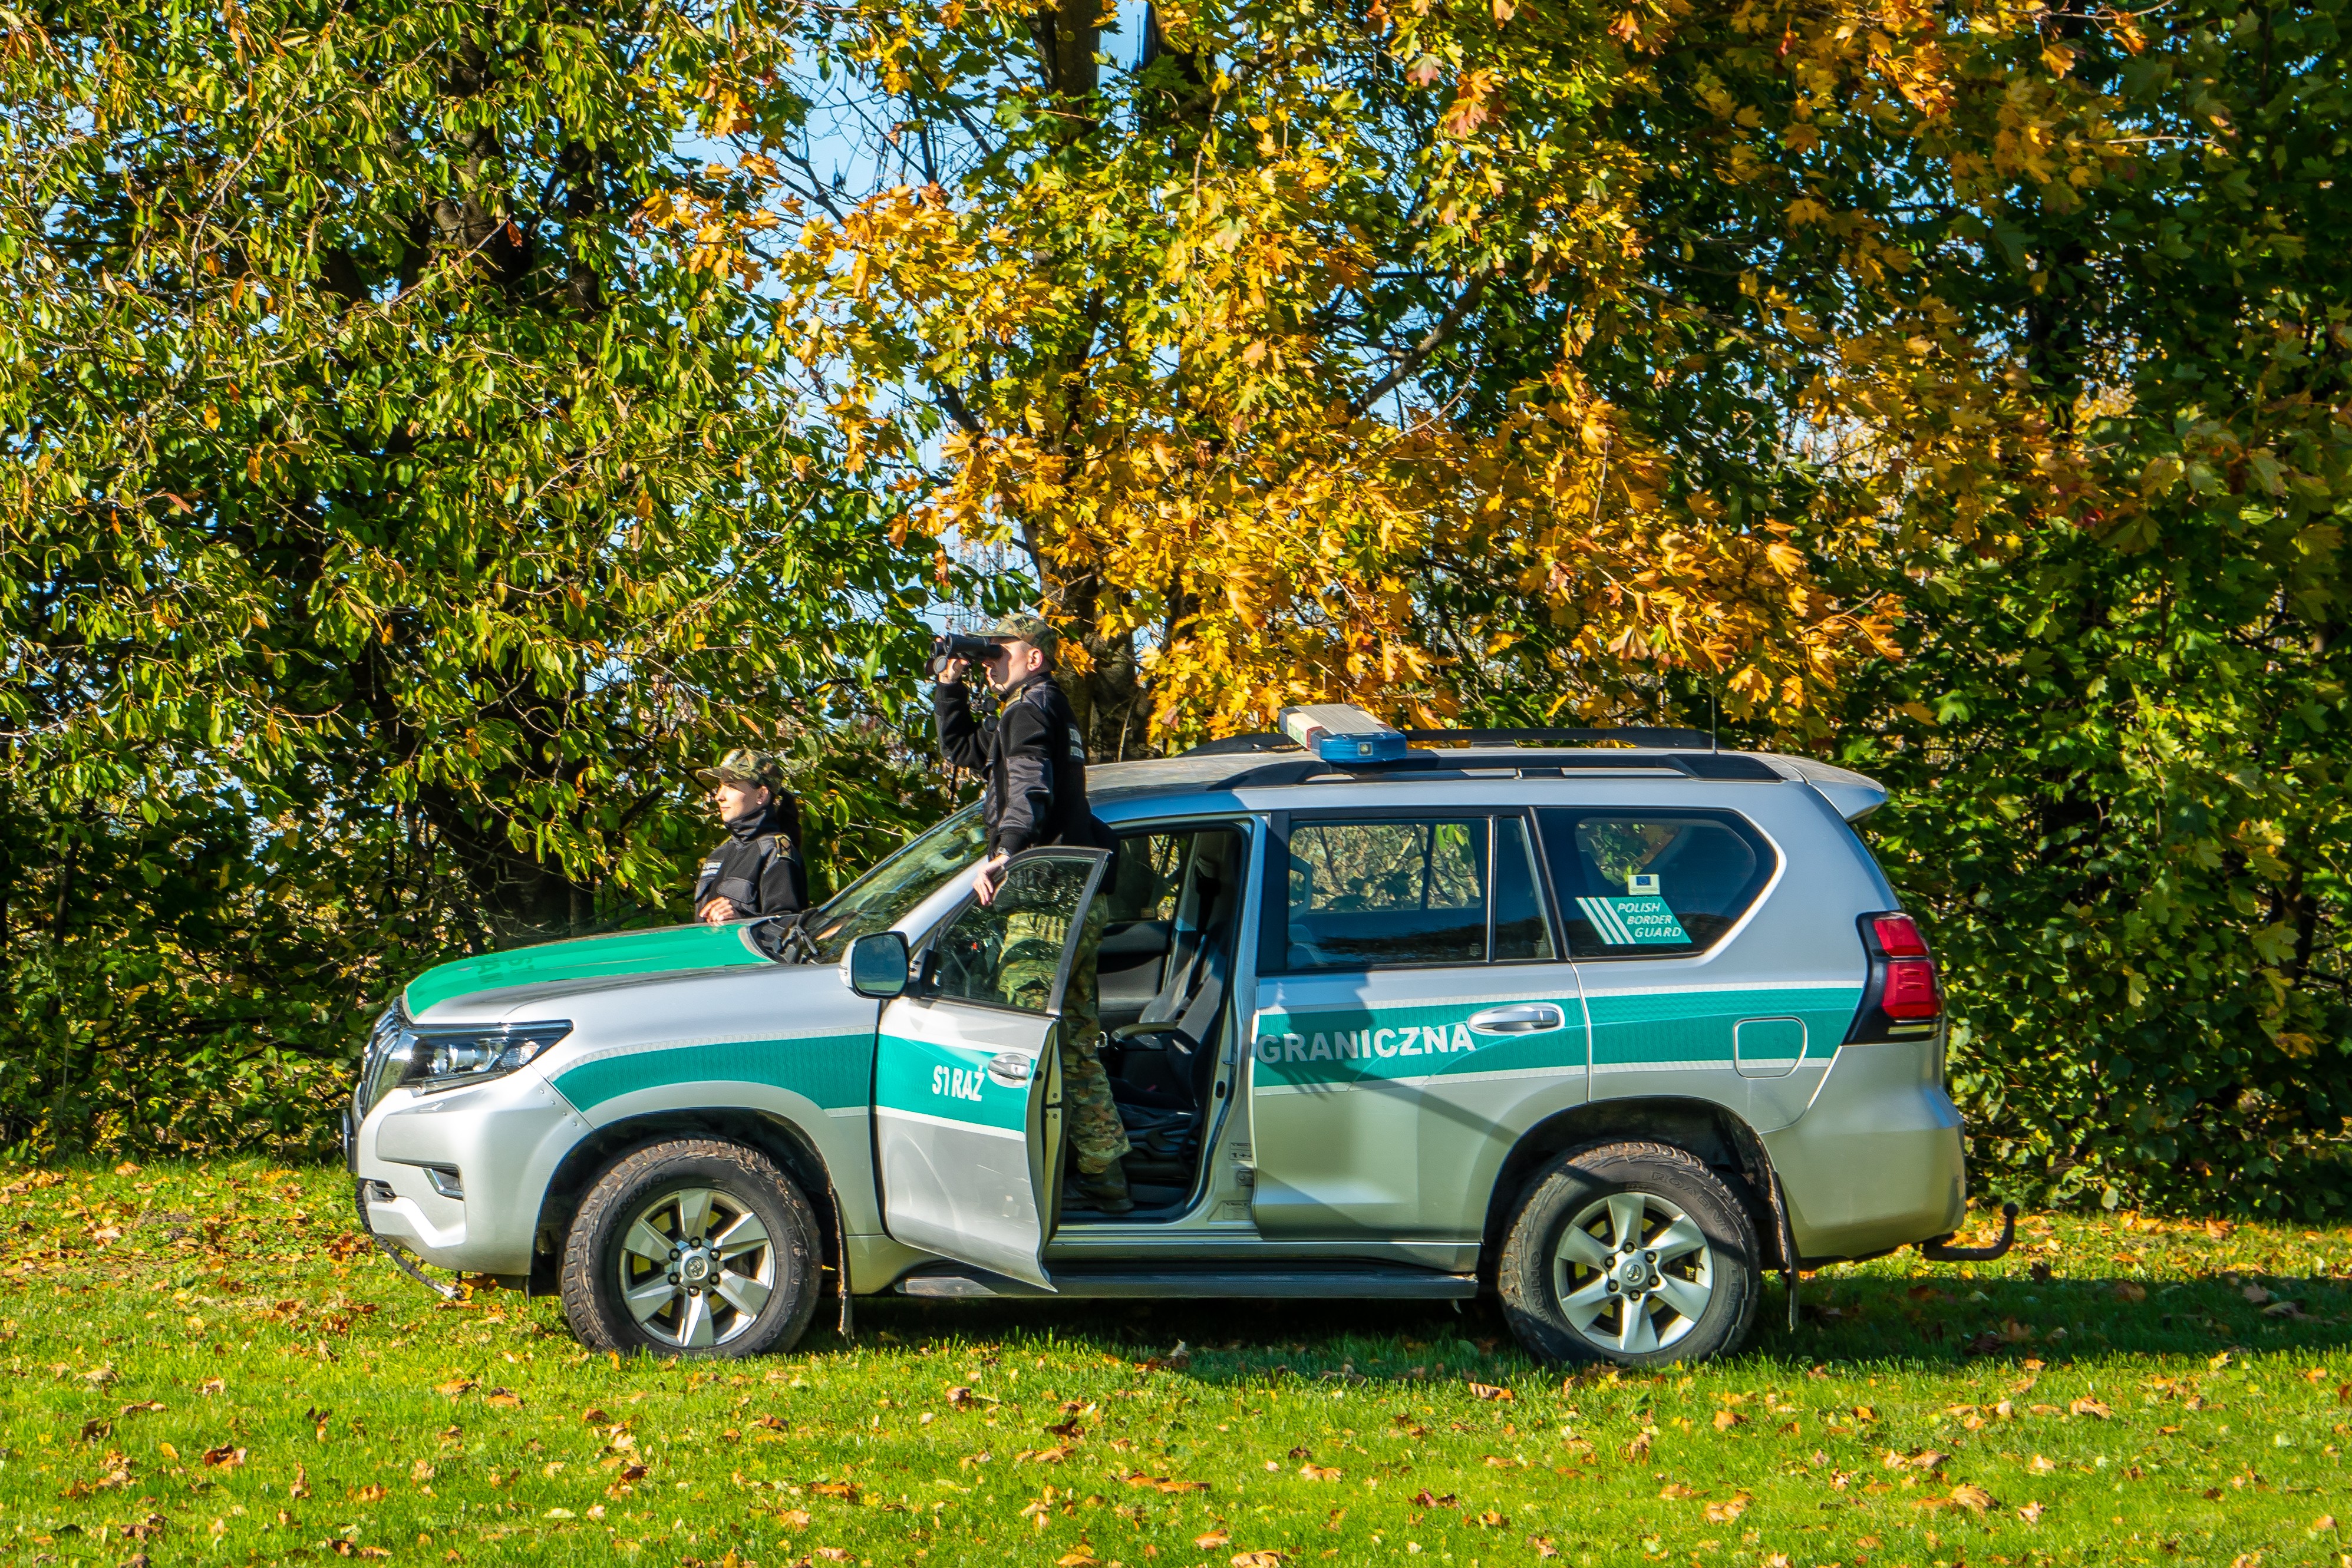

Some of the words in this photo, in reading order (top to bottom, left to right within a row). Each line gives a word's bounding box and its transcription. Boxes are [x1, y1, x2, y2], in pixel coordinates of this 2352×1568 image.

[1617, 902, 1661, 913] POLISH
[1627, 915, 1673, 925] BORDER
[1635, 926, 1681, 938] GUARD
[1257, 1024, 1477, 1064] GRANICZNA
[1651, 1171, 1713, 1210] ROAD
[1530, 1251, 1553, 1327] UMHO
